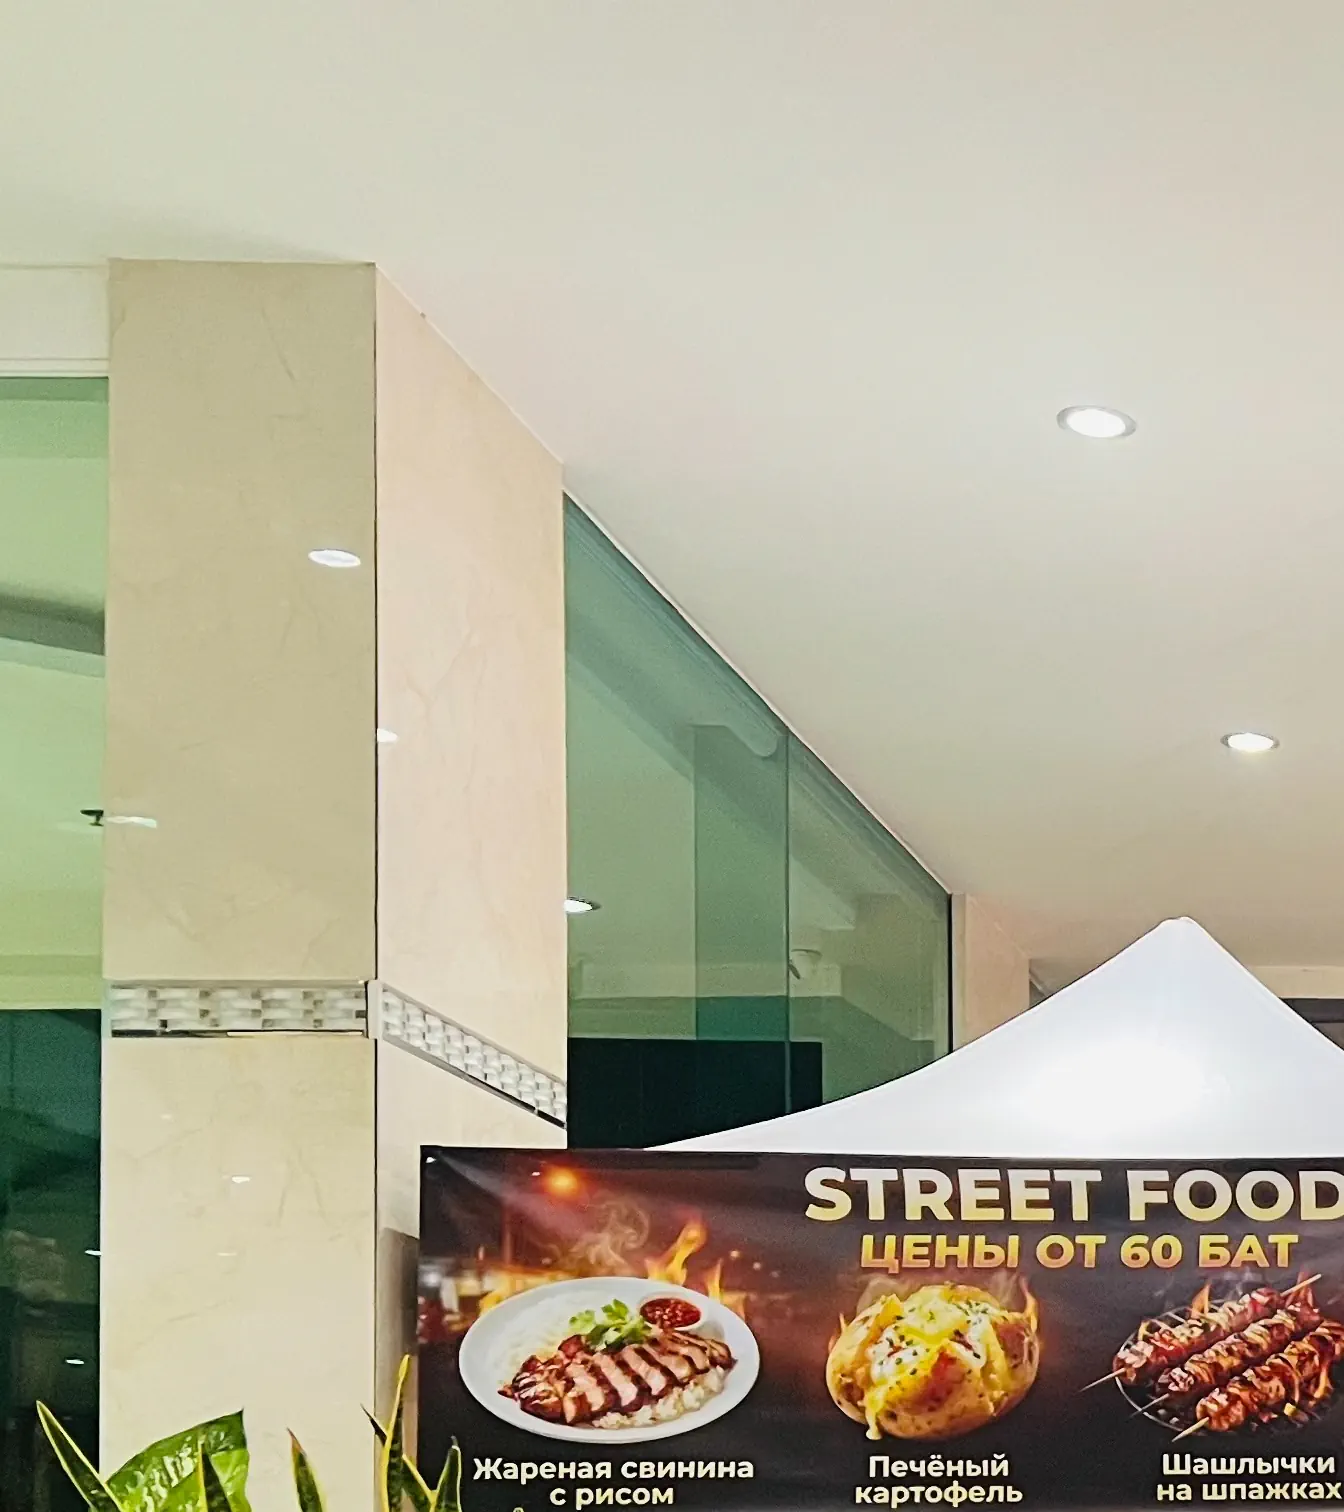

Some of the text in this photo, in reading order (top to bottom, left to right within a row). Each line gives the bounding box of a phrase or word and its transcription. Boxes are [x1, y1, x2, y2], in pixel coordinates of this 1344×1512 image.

[804, 1166, 1103, 1223] STREET
[860, 1233, 1300, 1276] ЦЕНЫ ОТ 60 БАТ
[472, 1457, 755, 1486] Жареная свинина
[868, 1453, 1010, 1481] Печёный
[1161, 1452, 1336, 1477] Шашлычки
[549, 1484, 675, 1511] с рисом
[854, 1480, 1024, 1510] картофель
[1156, 1478, 1343, 1502] на шпажках
